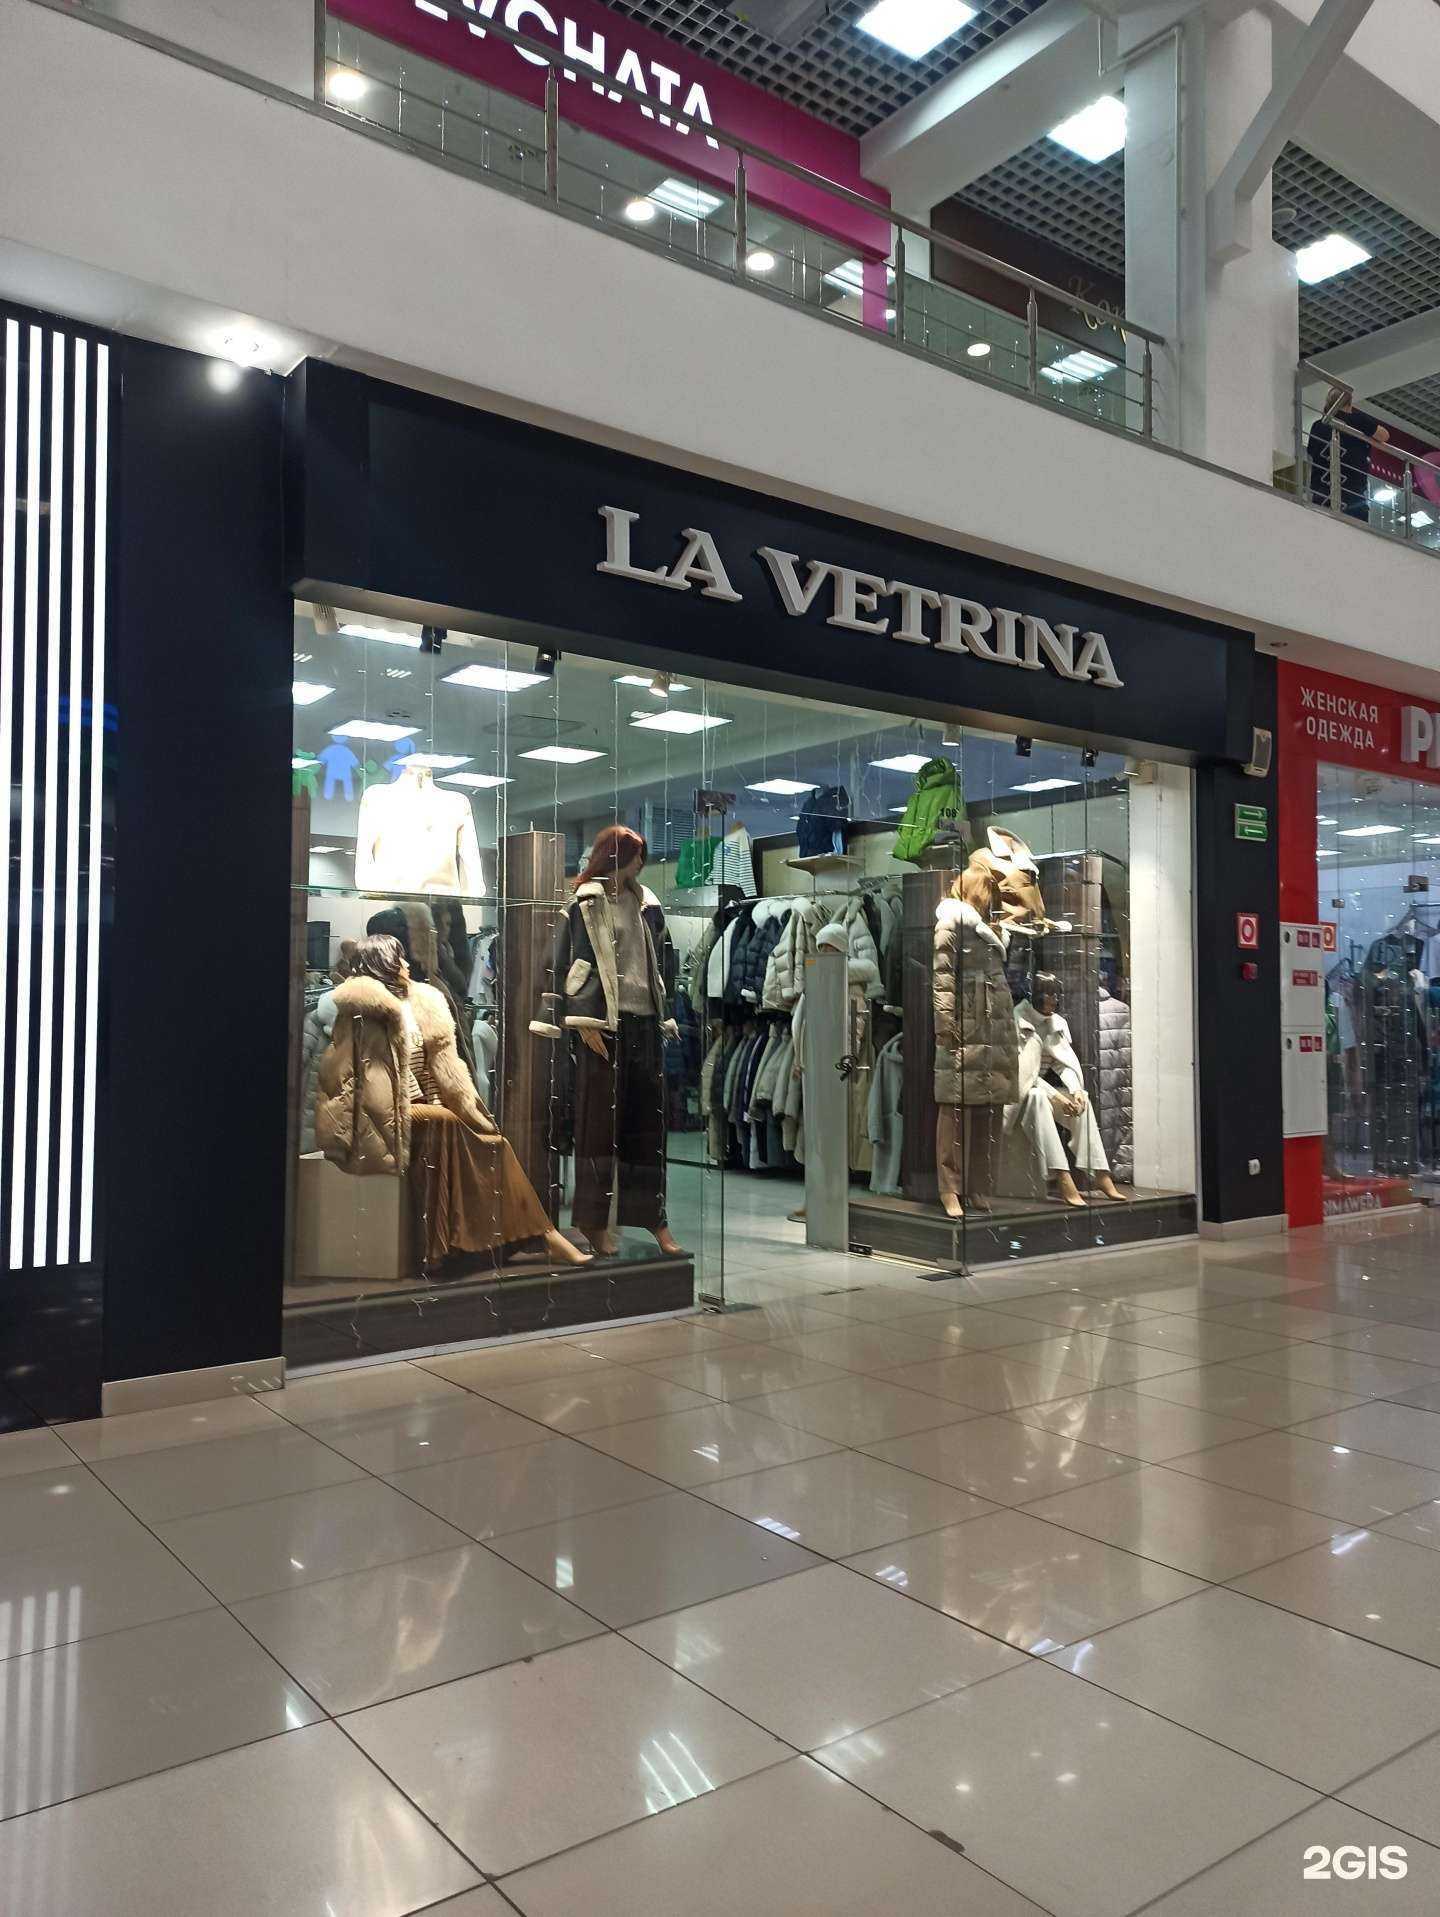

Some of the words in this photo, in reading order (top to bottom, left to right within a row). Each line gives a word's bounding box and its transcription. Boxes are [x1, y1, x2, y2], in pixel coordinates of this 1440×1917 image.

[597, 505, 743, 602] LA
[757, 546, 1125, 688] VETRINA
[1300, 686, 1379, 724] ЖЕНСКАЯ
[1306, 716, 1375, 750] ОДЕЖДА
